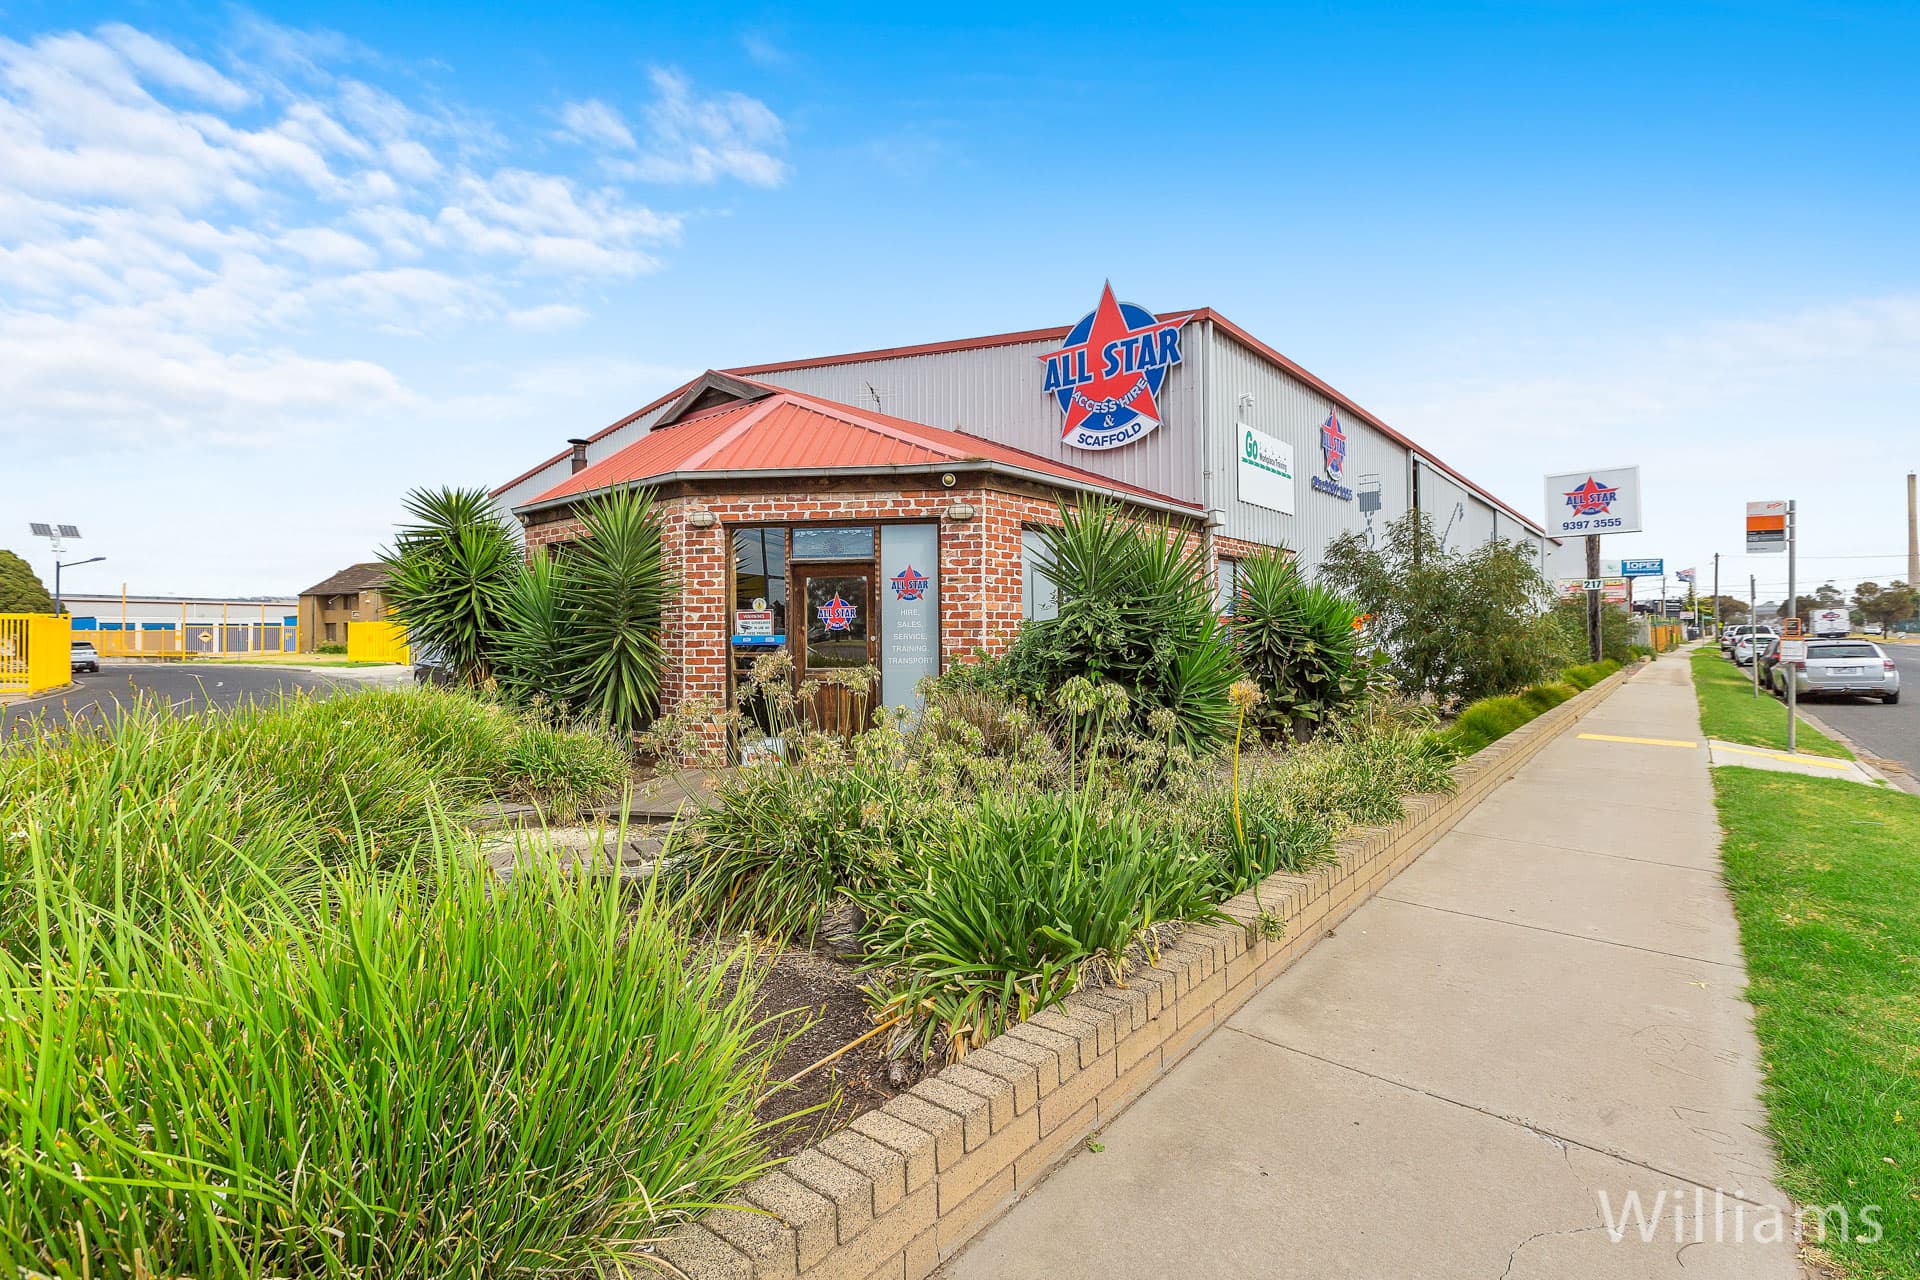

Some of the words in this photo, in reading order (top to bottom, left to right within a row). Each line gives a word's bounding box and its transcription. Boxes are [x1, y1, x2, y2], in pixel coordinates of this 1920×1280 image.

[1043, 349, 1094, 391] ALL
[1102, 328, 1182, 379] STAR
[1072, 391, 1117, 413] ACCESS
[1119, 377, 1148, 408] HIRE
[1103, 414, 1115, 428] &
[1077, 422, 1142, 446] SCAFFOLD
[1245, 430, 1258, 460] Go
[1566, 495, 1585, 506] ALL
[1590, 491, 1617, 503] STAR
[1562, 520, 1590, 531] 9397
[1593, 517, 1622, 528] 3555
[891, 580, 905, 590] ALL
[909, 580, 929, 590] STAR
[1584, 580, 1601, 589] 217
[818, 608, 833, 618] ALL
[835, 607, 857, 618] STAR
[888, 656, 934, 664] TRANSPORT
